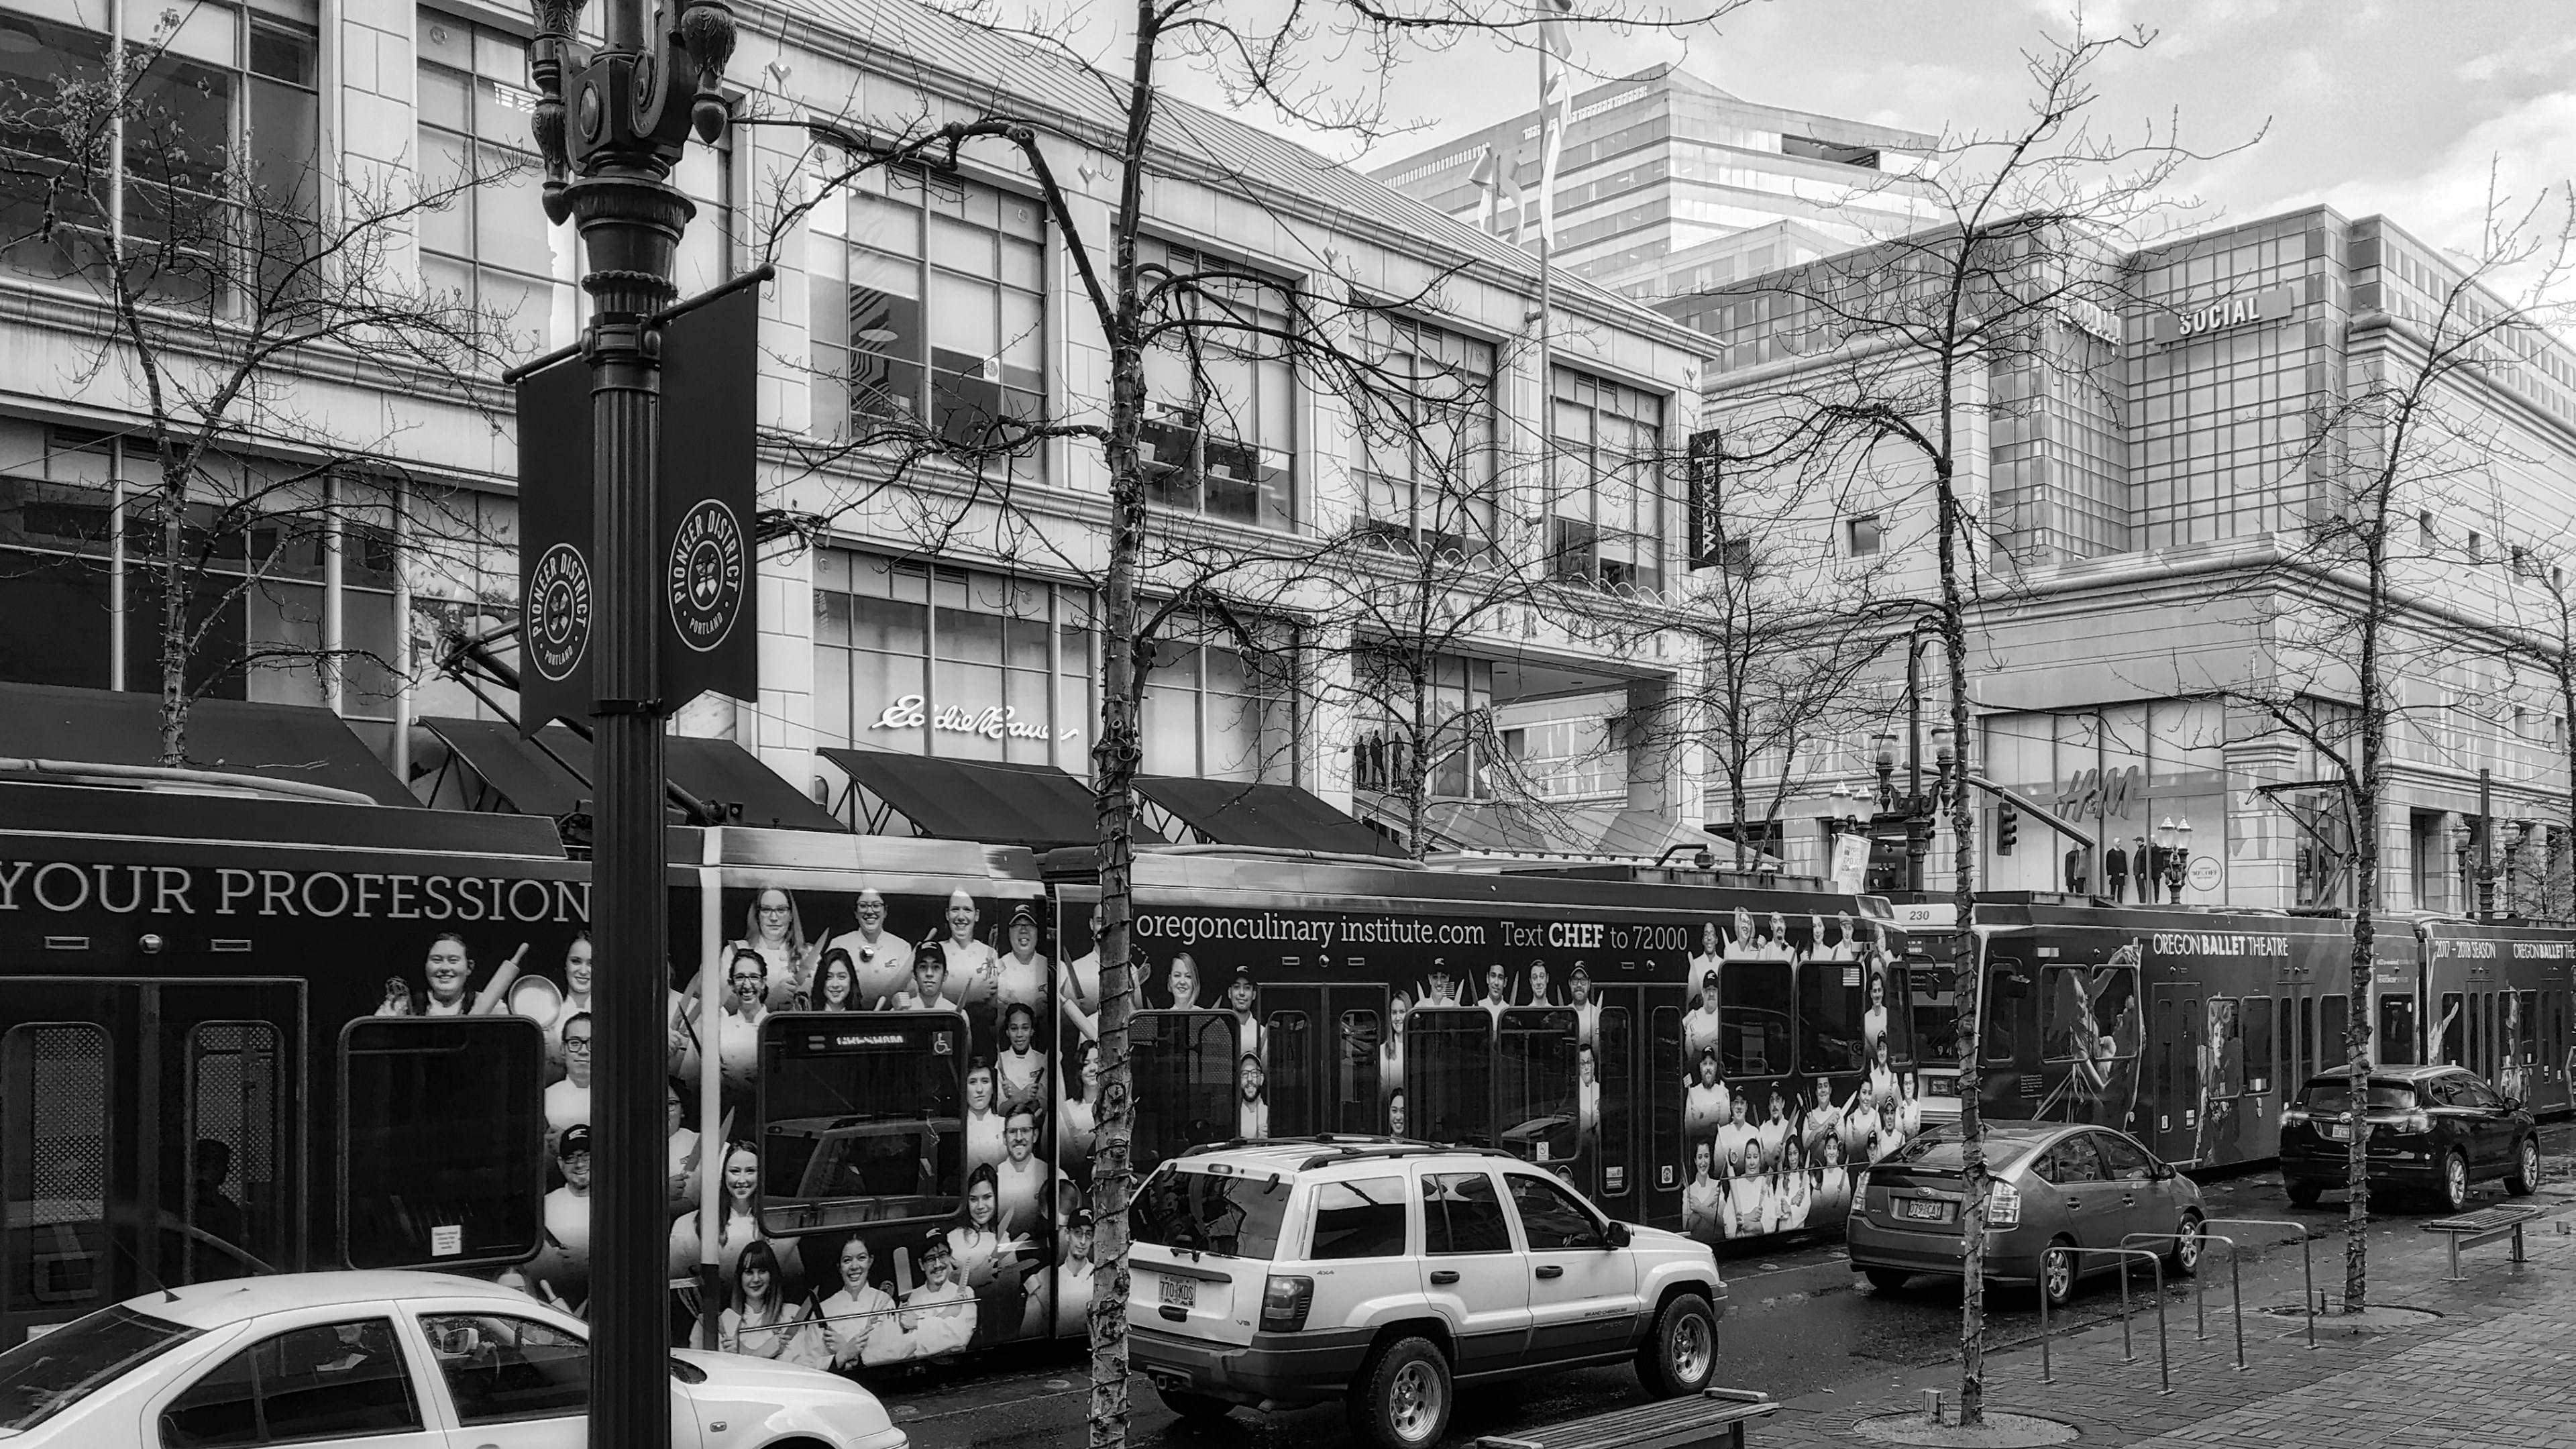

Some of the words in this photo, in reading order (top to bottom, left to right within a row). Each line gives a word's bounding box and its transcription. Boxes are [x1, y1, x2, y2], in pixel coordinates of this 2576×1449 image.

[2180, 297, 2260, 335] SOCIAL
[673, 515, 703, 604] PIONEER
[707, 510, 739, 592] DISTRICT
[531, 557, 557, 637] PIONEER
[560, 553, 587, 627] DISTRICT
[689, 612, 723, 635] PORTLAND
[545, 645, 573, 665] PORTLAND
[2057, 765, 2139, 822] H&M
[0, 861, 195, 913] YOUR
[1909, 911, 1929, 920] 230
[1136, 913, 1335, 948] oregonculinary
[1341, 916, 1486, 945] institute.com
[1501, 921, 1543, 947] Text
[1548, 922, 1604, 948] CHEF
[1610, 927, 1628, 949] to
[1633, 926, 1687, 950] 72000
[2153, 933, 2200, 955] OREGON
[2201, 934, 2245, 955] BALLET
[2247, 936, 2289, 956] THEATRE
[2435, 941, 2449, 957] 2017
[2457, 941, 2471, 958] 2018
[2471, 942, 2496, 959] SEASON
[2514, 943, 2539, 959] OREGON
[2539, 944, 2563, 959] BALLET
[1160, 1281, 1175, 1297] 770
